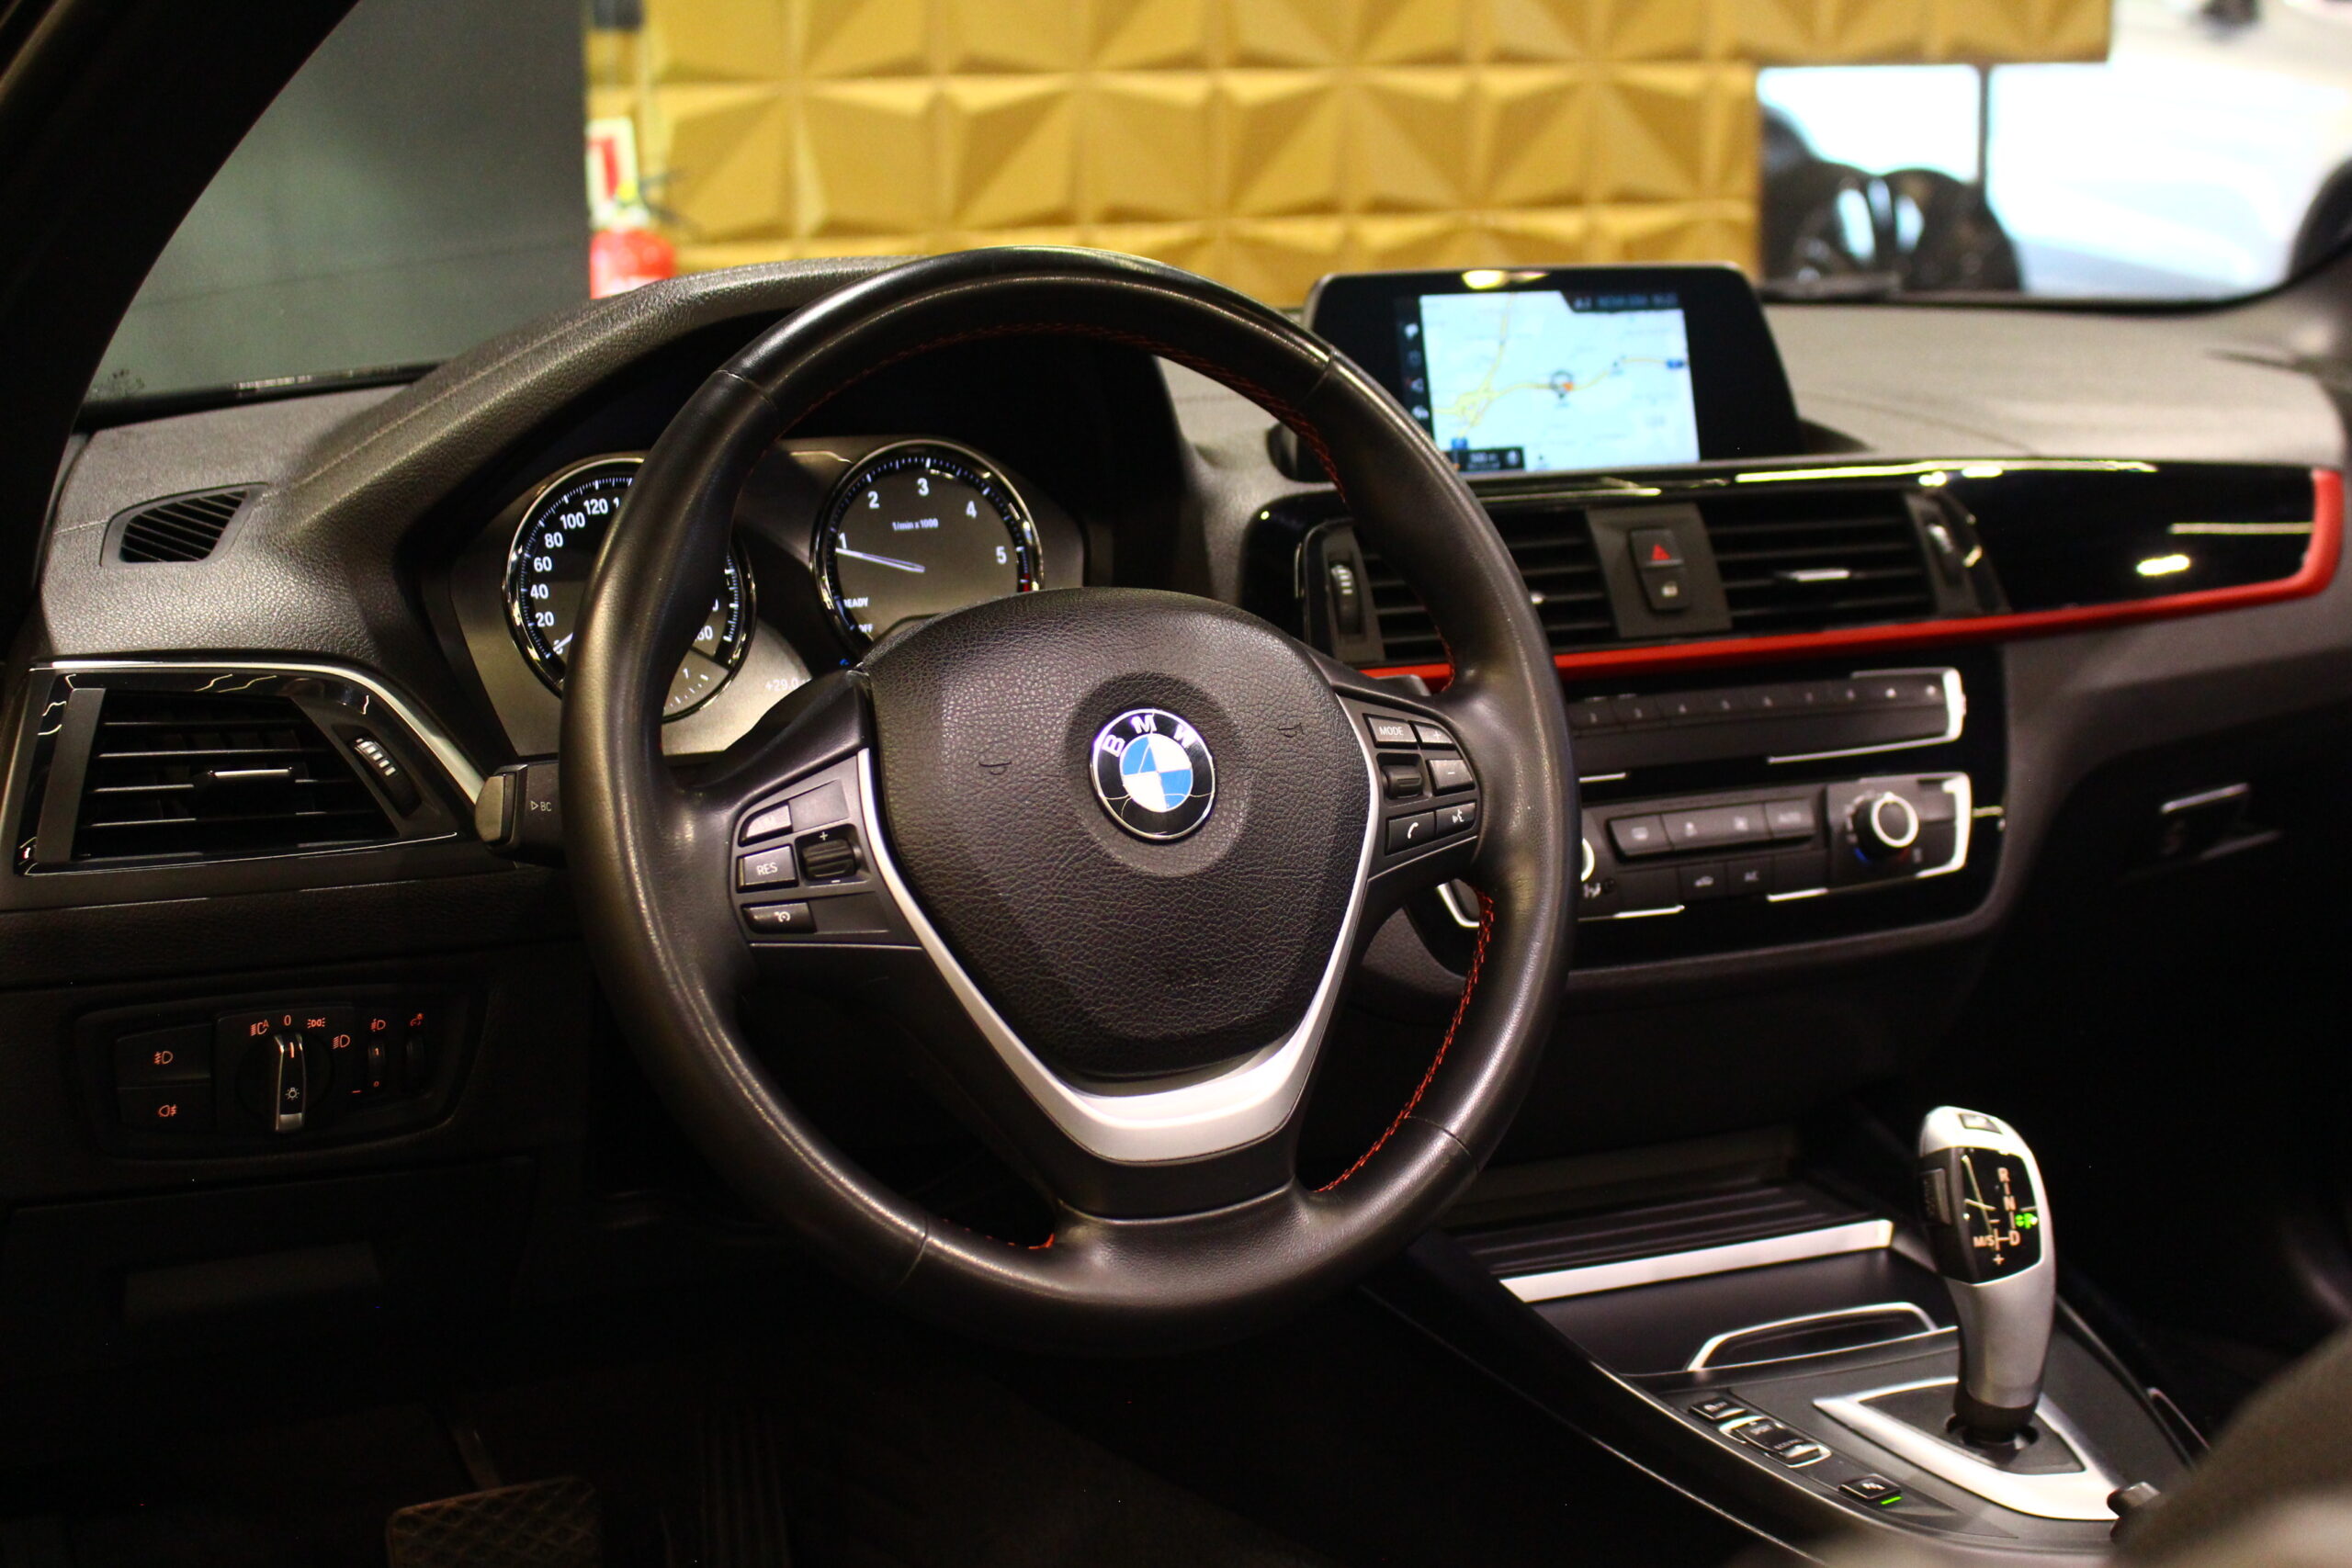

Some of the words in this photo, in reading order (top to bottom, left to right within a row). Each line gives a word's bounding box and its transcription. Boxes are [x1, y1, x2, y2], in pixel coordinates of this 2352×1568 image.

[917, 478, 929, 496] 3
[583, 498, 608, 515] 120
[867, 491, 879, 509] 2
[966, 501, 977, 518] 4
[560, 512, 585, 530] 100
[544, 532, 563, 548] 80
[838, 533, 847, 549] 1
[995, 546, 1007, 564] 5
[533, 556, 552, 572] 60
[530, 583, 549, 600] 40
[535, 611, 555, 627] 20
[1102, 714, 1199, 758] BMW
[1379, 727, 1404, 736] MODE
[540, 801, 551, 812] BC
[757, 862, 778, 875] RES
[283, 1014, 292, 1027] 0
[1997, 1168, 2010, 1183] R
[2004, 1196, 2017, 1211] N
[2008, 1230, 2020, 1247] D
